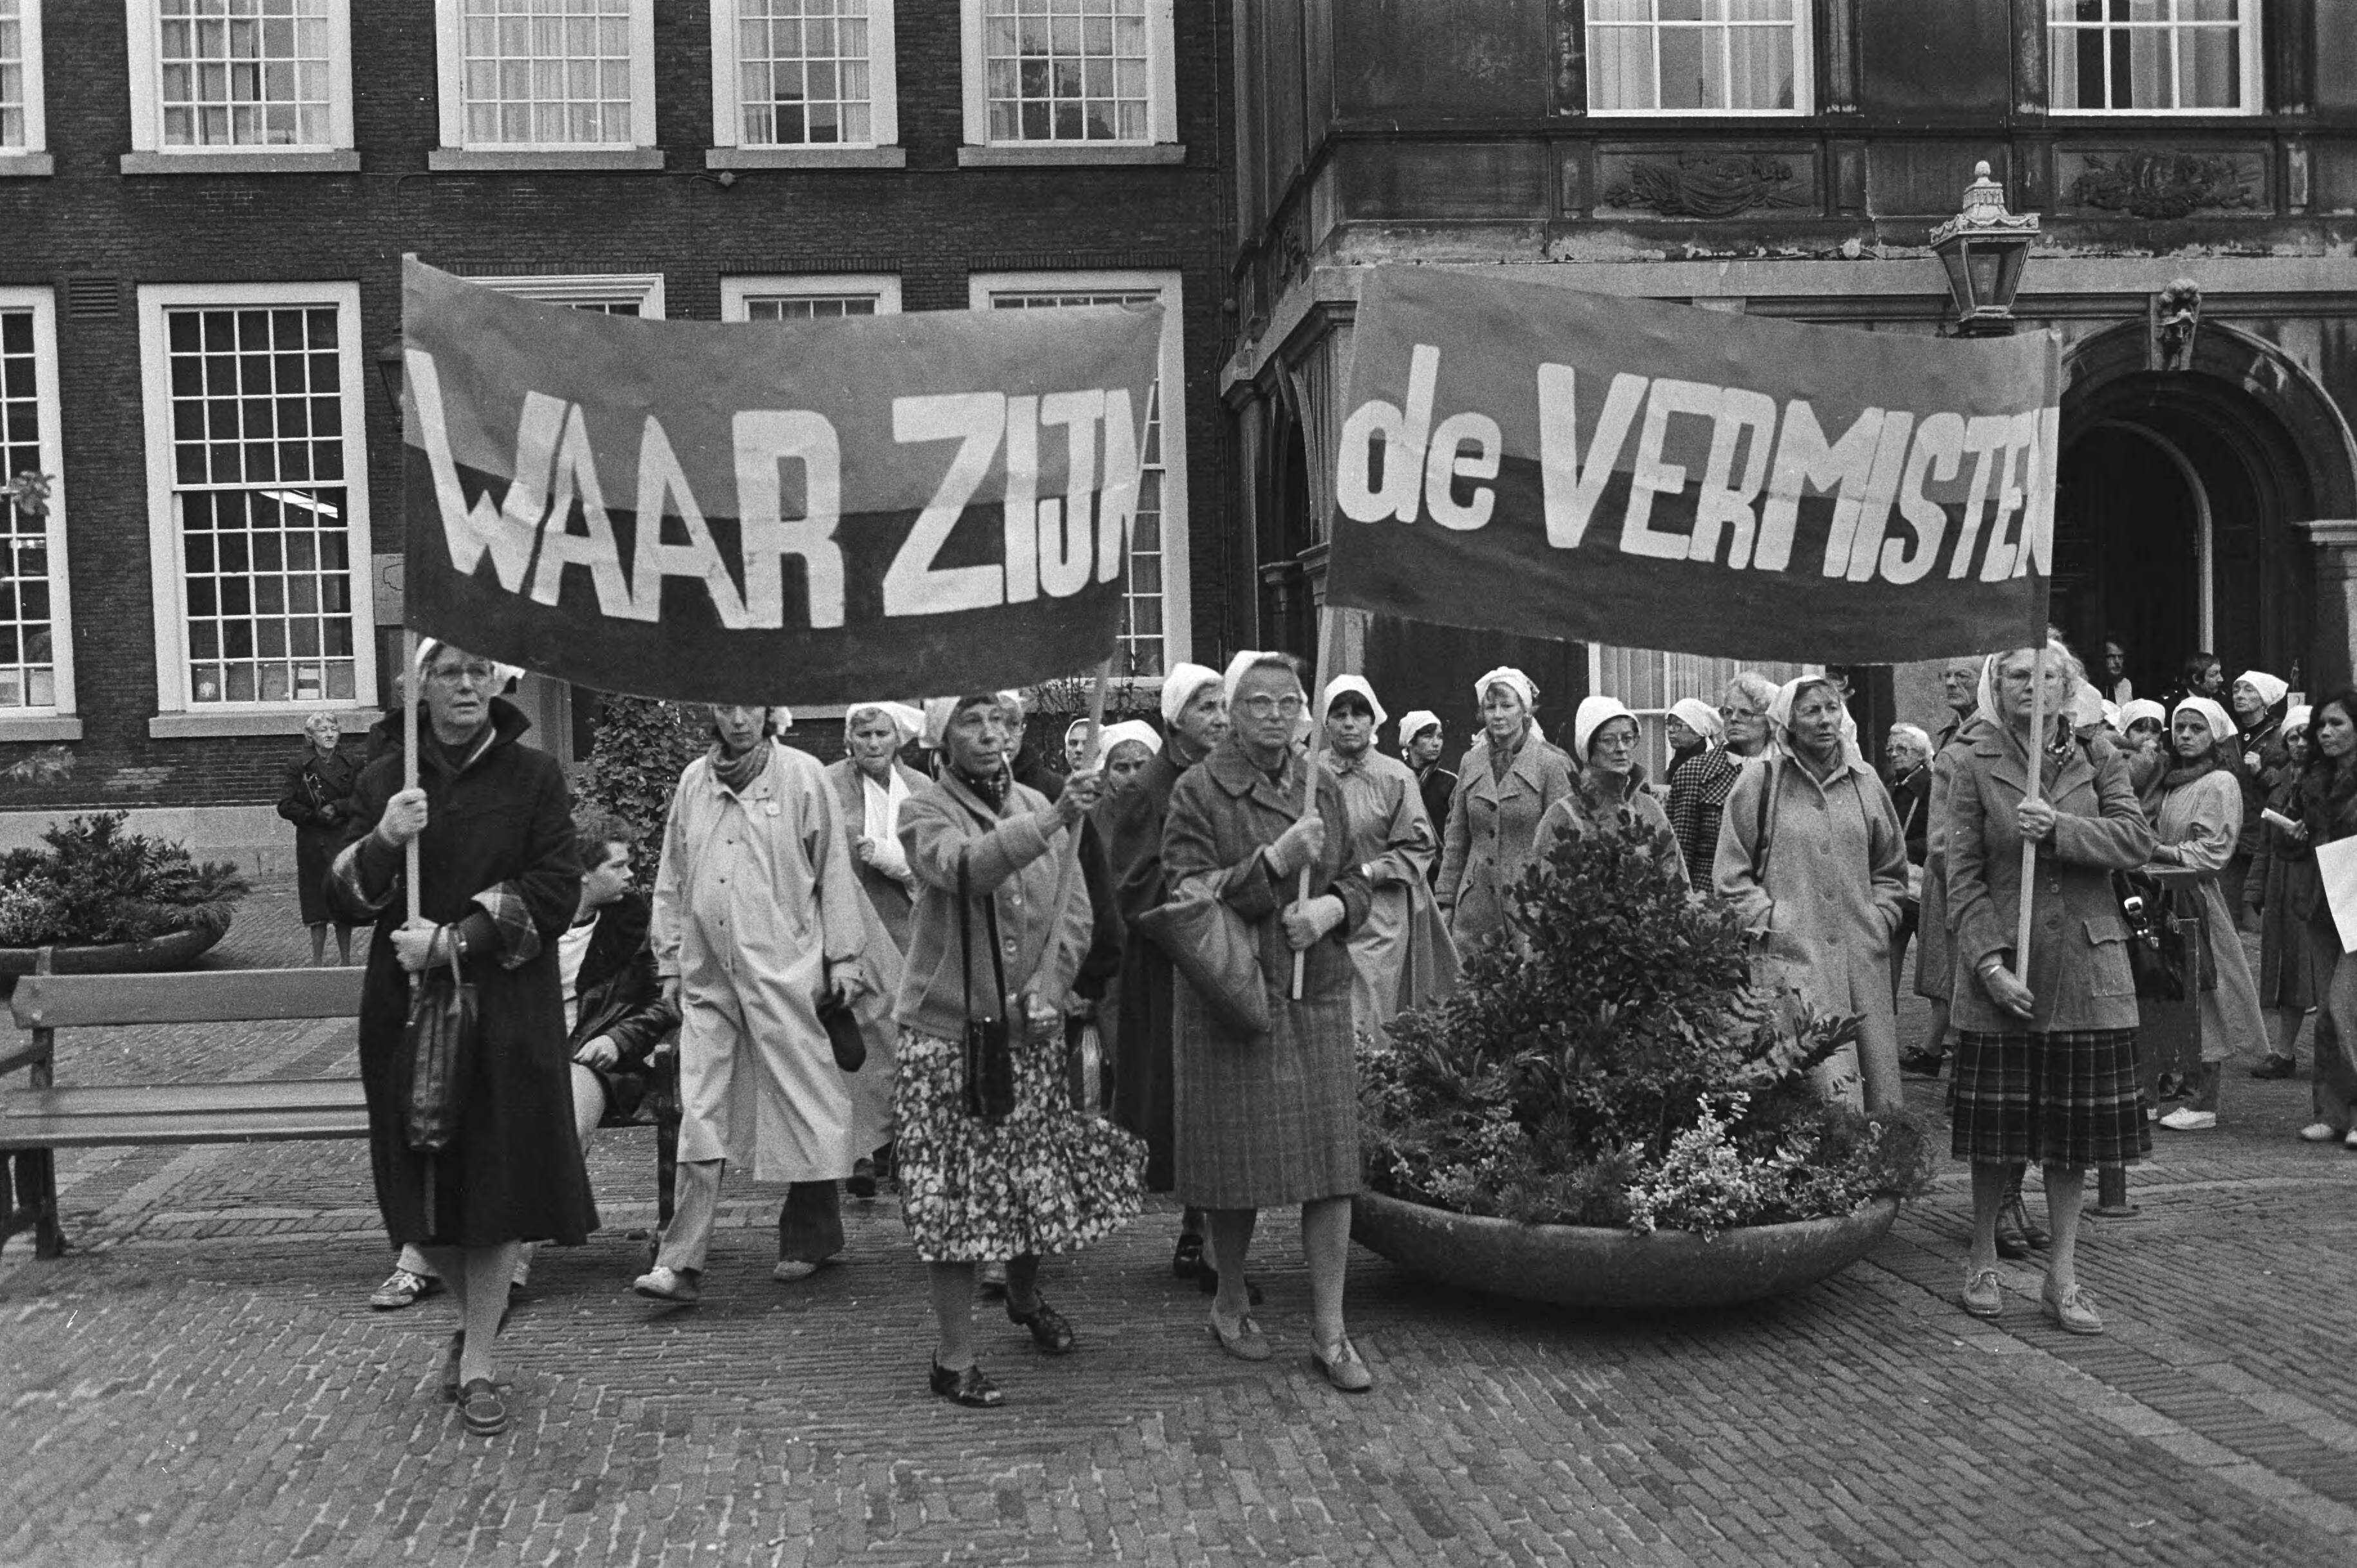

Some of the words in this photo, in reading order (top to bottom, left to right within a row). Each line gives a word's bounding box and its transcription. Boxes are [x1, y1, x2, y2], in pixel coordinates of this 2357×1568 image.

[404, 348, 845, 629] WAAR
[883, 388, 1140, 617] ZIJN
[1337, 344, 1502, 530] de
[1537, 362, 2060, 584] VERMISTEN
